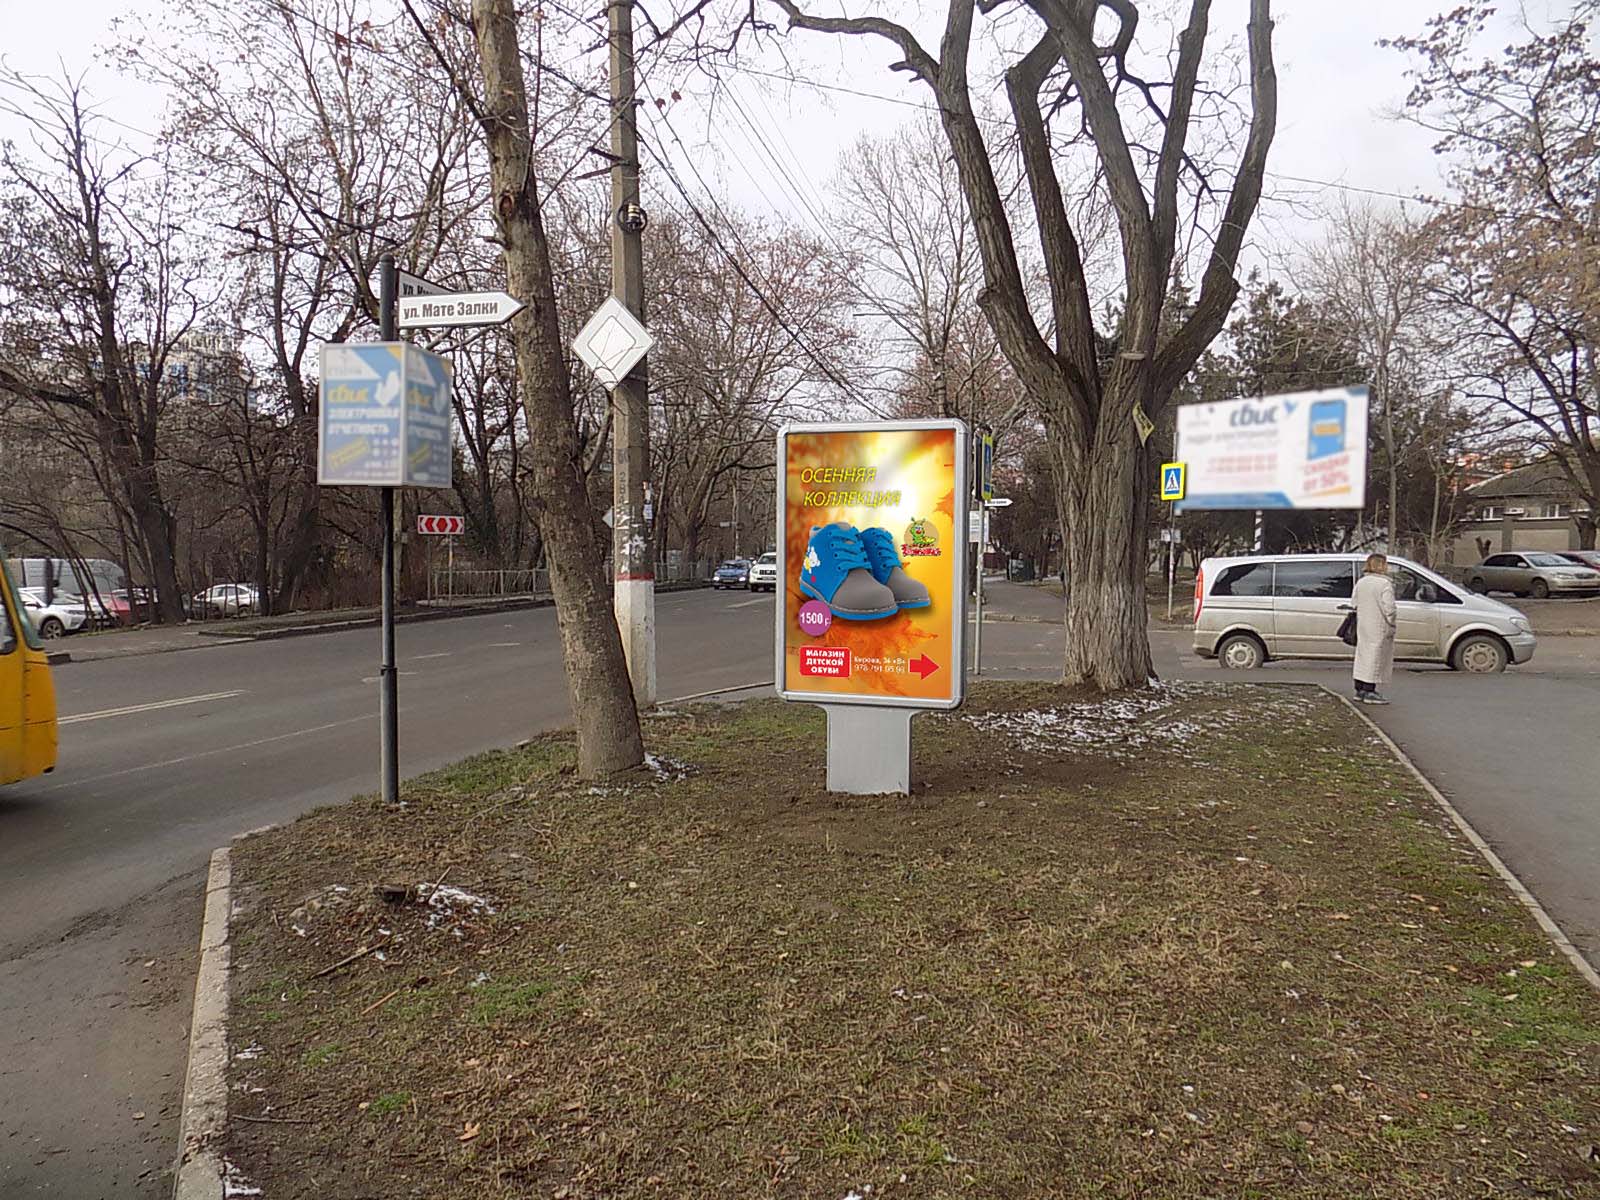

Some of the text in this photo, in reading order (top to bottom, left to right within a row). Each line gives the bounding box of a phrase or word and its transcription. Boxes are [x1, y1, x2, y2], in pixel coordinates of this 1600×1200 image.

[403, 301, 498, 319] ул. Мате Залки
[801, 467, 876, 484] ОСЕННЯЯ
[803, 490, 902, 508] КОЛЛЕКЦИЯ
[800, 612, 824, 624] 1500
[805, 649, 845, 659] МАГАЗИН
[806, 658, 844, 666] ДЕТСКОЙ
[811, 666, 840, 674] ОБУВИ
